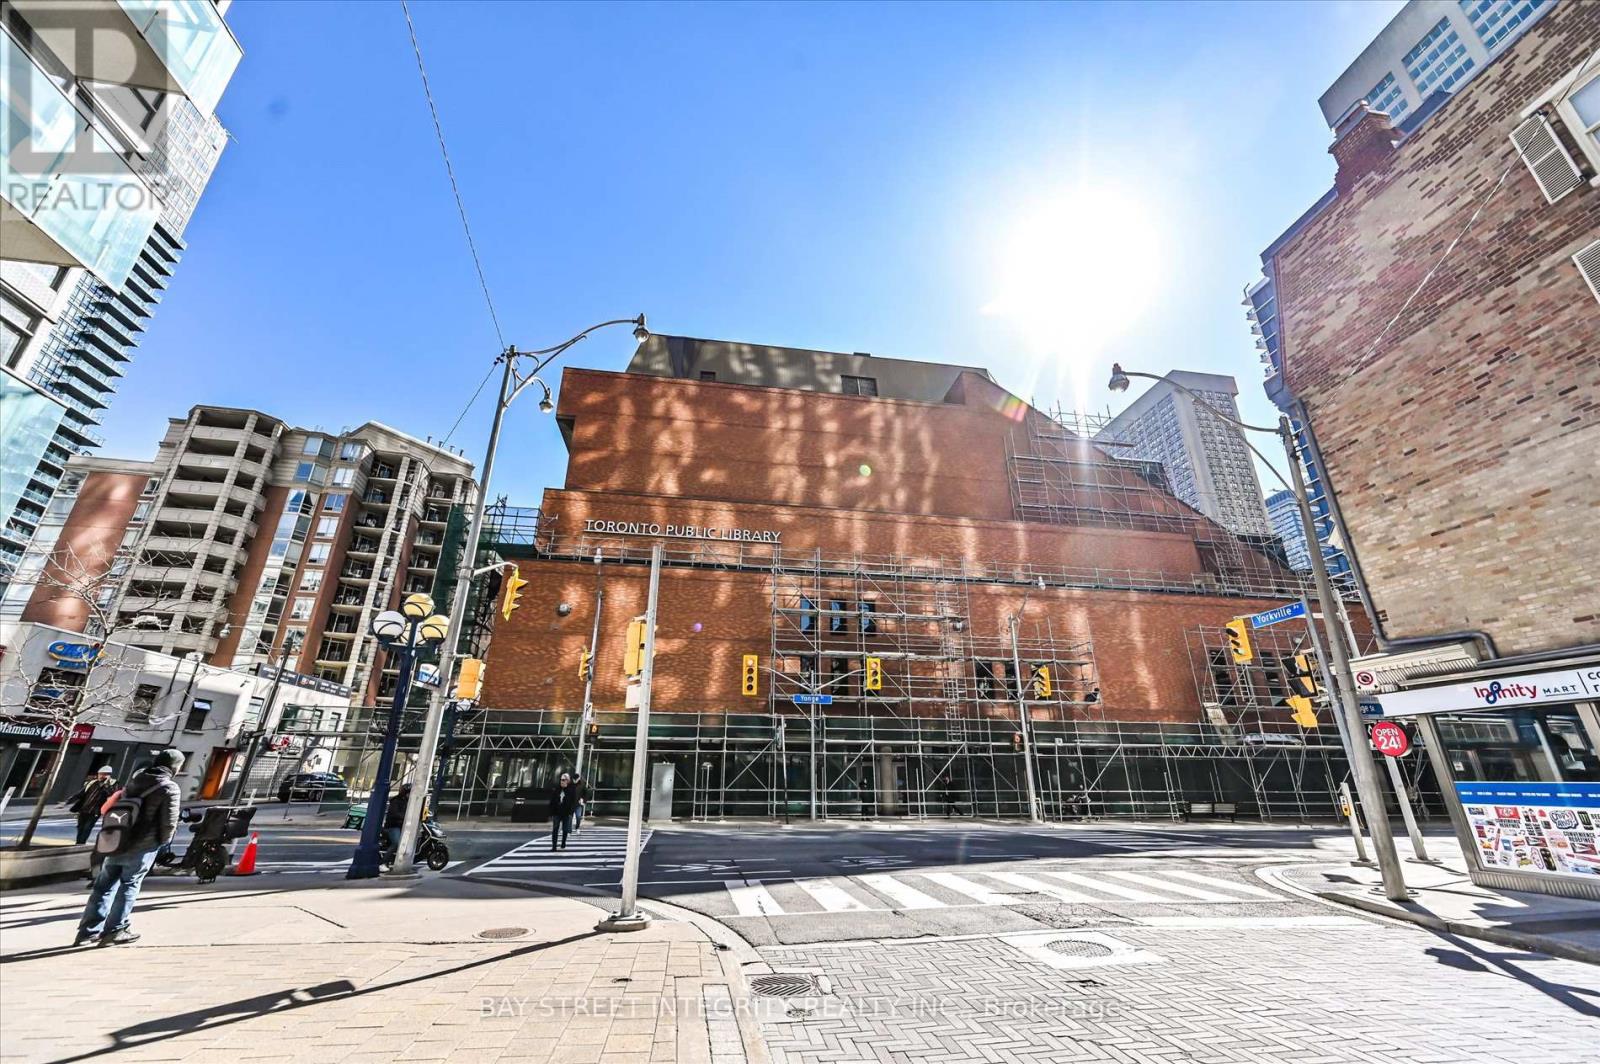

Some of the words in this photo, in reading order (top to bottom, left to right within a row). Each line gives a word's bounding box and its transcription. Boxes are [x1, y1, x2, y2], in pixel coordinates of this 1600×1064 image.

[585, 519, 660, 535] TORONTO
[666, 525, 716, 538] PUBLIC
[722, 527, 781, 542] LIBRARY
[1256, 607, 1292, 623] Yorkville
[1543, 685, 1577, 695] MART
[1375, 727, 1399, 737] OPEN
